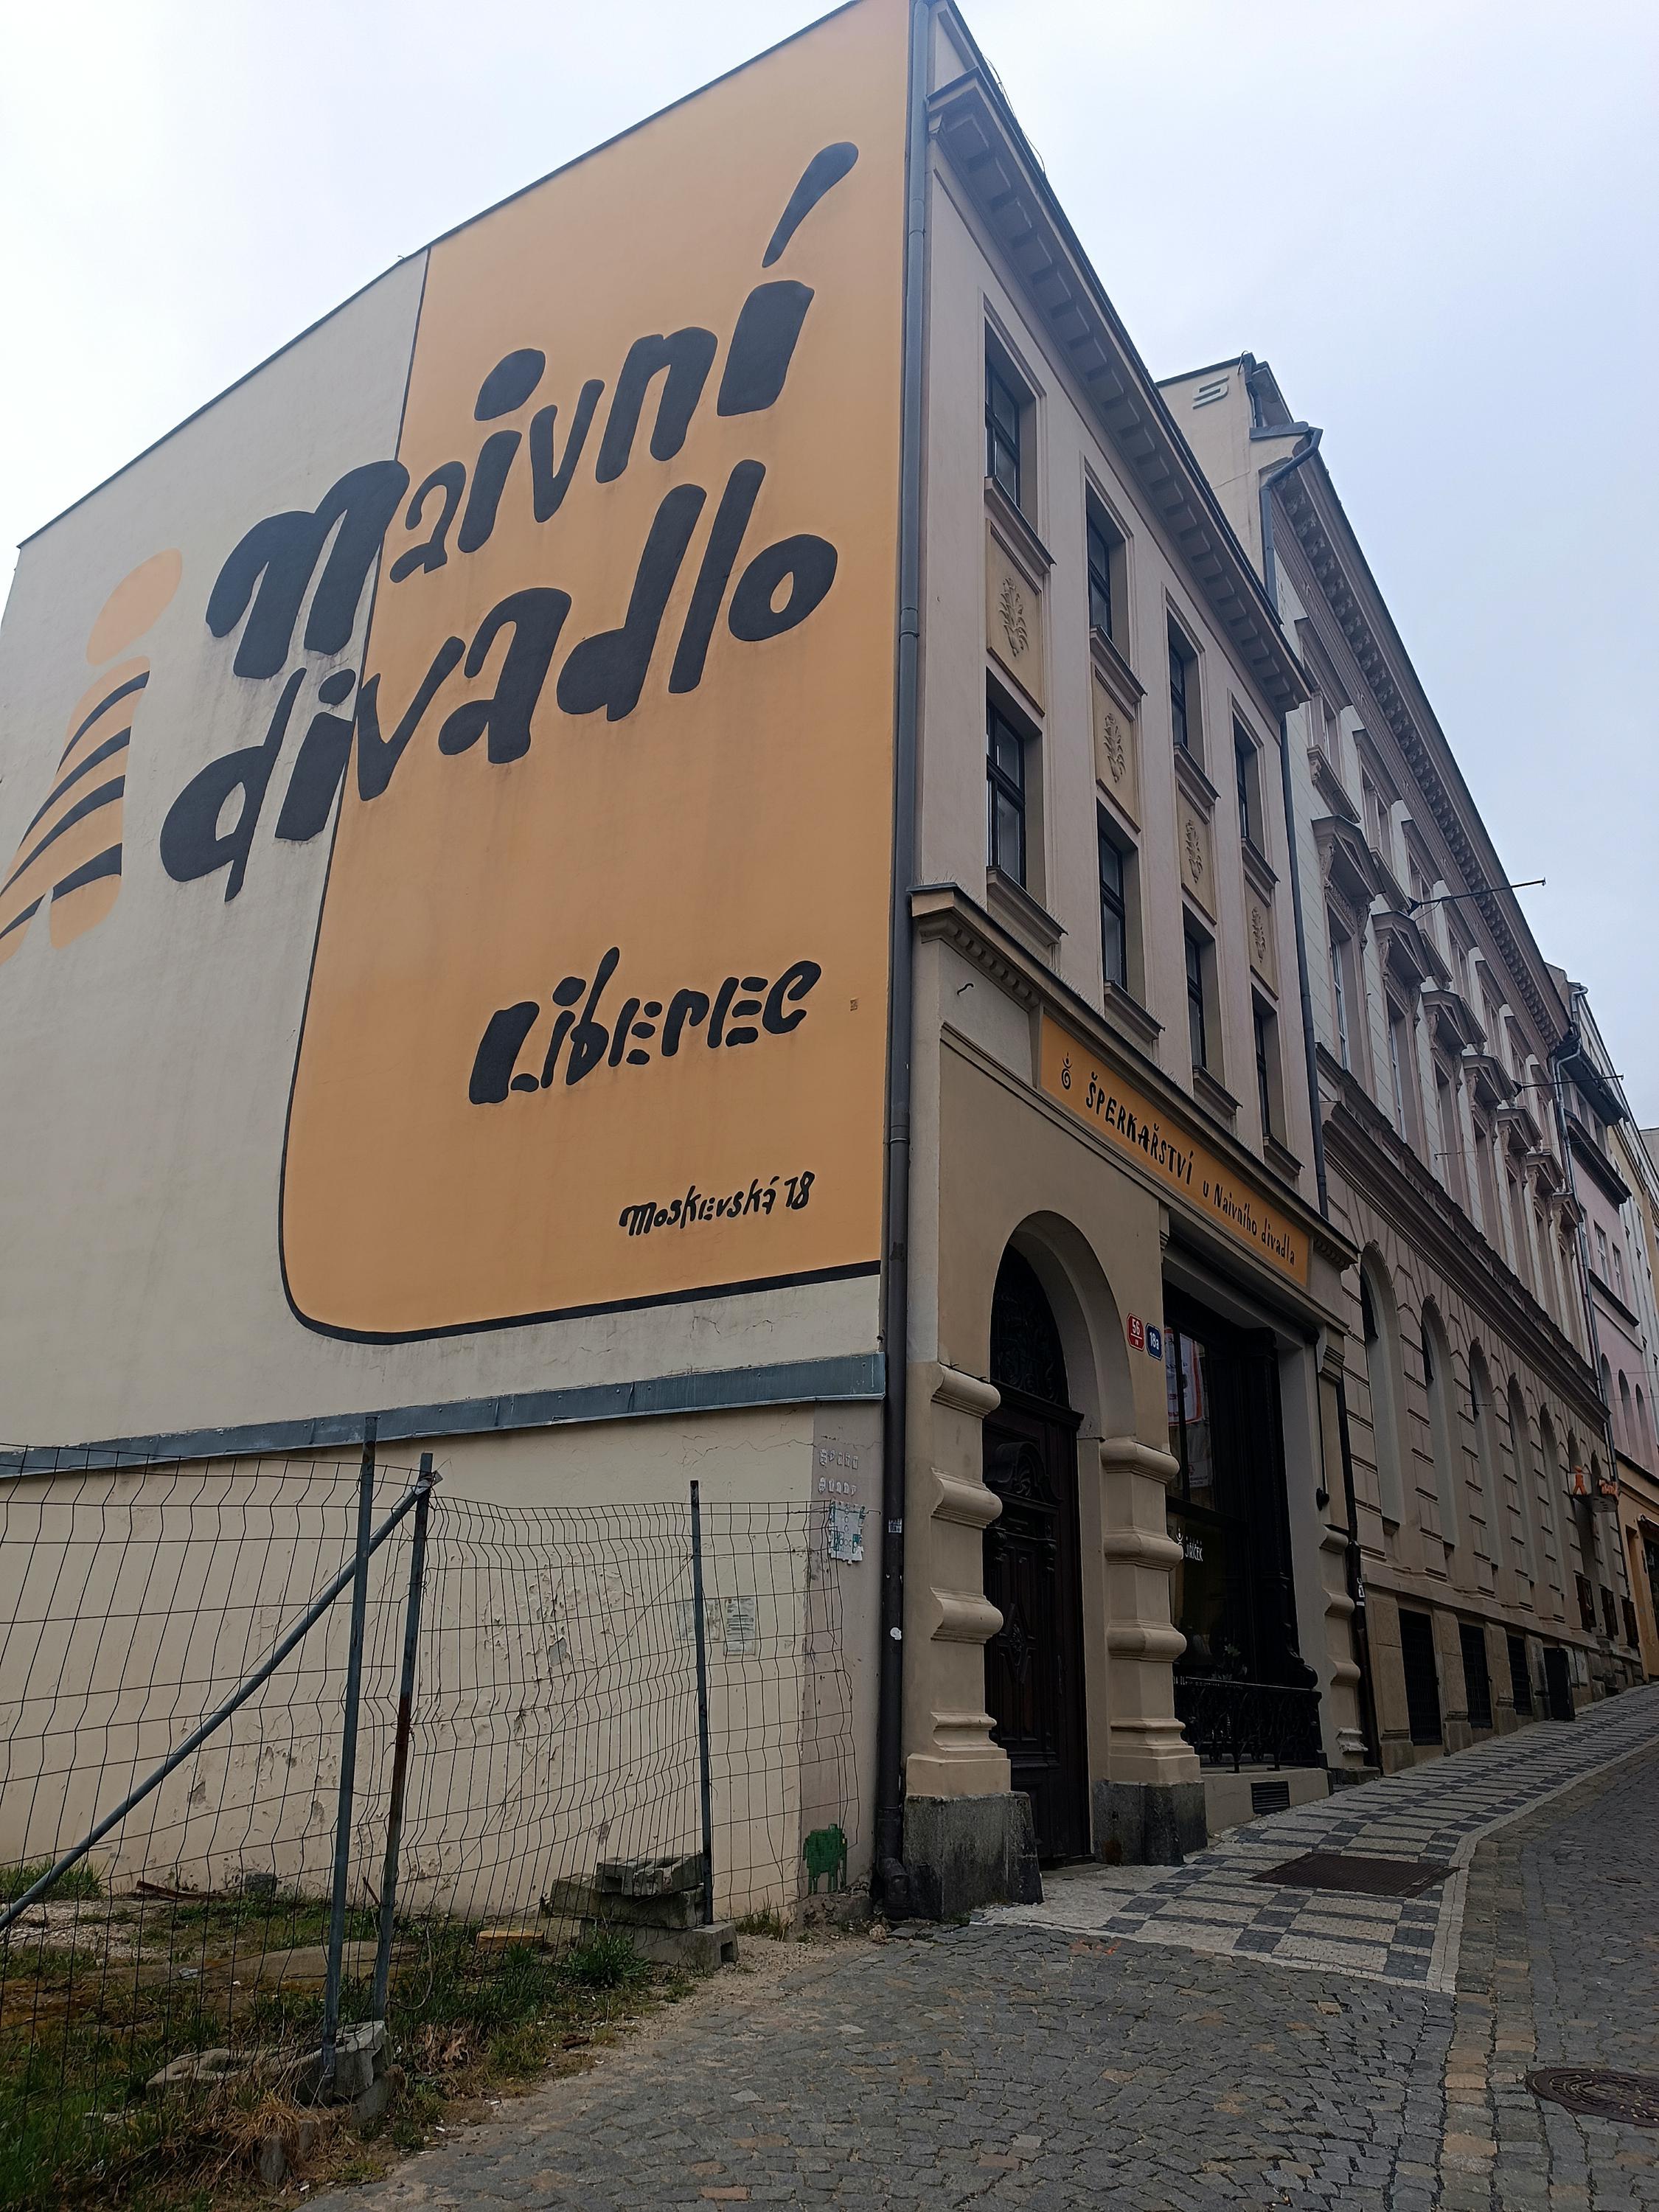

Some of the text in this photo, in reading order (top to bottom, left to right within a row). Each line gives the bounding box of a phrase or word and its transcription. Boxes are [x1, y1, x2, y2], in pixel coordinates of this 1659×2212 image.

[160, 459, 838, 902] divadlo
[1085, 1071, 1194, 1186] ŠPERKAŘSTVÍ
[1214, 1183, 1257, 1237] Naivního
[1261, 1217, 1295, 1266] divadla
[784, 1170, 815, 1210] 18
[1132, 1318, 1141, 1335] 56
[1150, 1332, 1159, 1350] 18a
